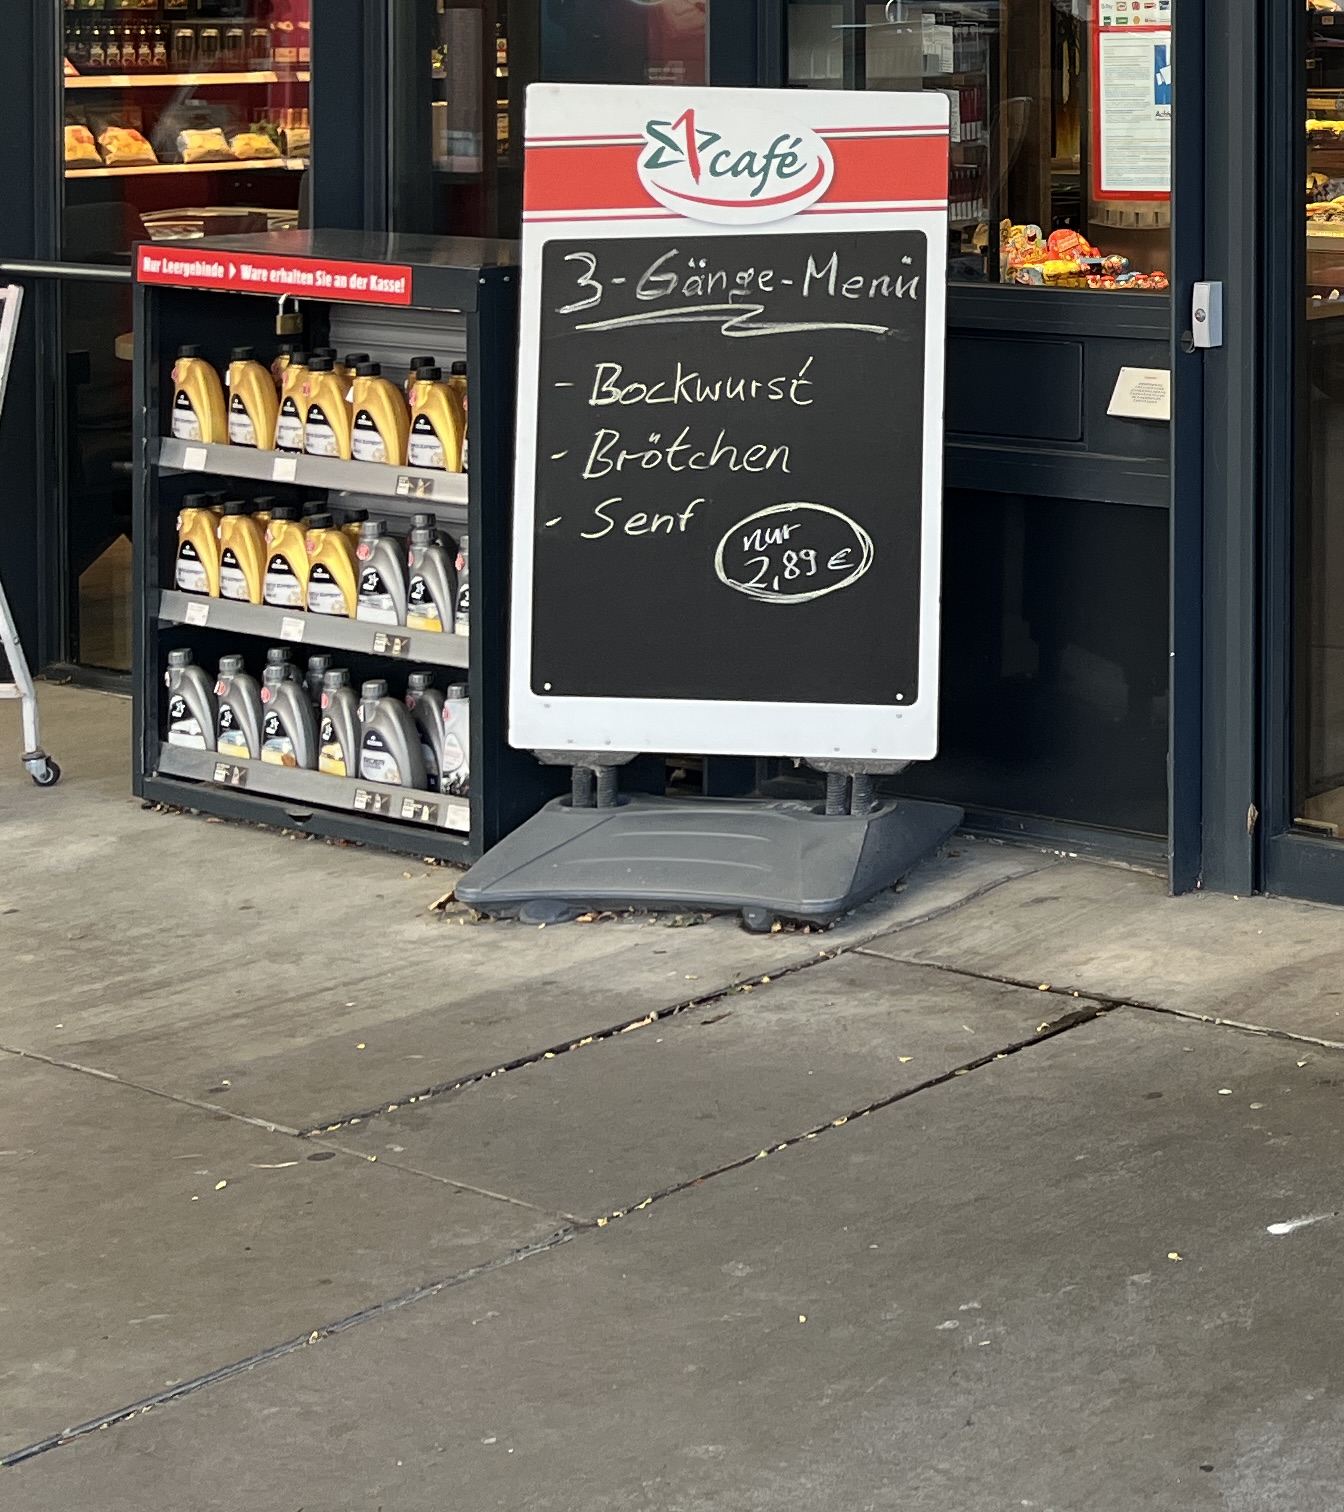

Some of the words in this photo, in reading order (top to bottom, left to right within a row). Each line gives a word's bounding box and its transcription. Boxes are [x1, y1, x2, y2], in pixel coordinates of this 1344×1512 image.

[708, 133, 808, 197] café
[142, 256, 161, 275] Nur
[162, 257, 224, 278] Leergebinde
[240, 264, 268, 282] Ware
[269, 265, 314, 286] erhalten
[315, 269, 332, 287] Sie
[333, 274, 348, 289] an
[349, 272, 368, 290] der
[369, 274, 405, 294] Kasse!
[588, 355, 815, 406] Bockwurst
[582, 426, 791, 479] Brötchen
[580, 496, 706, 539] Senf
[743, 522, 802, 553] nur
[743, 547, 818, 591] 2,89
[827, 546, 856, 571] €
